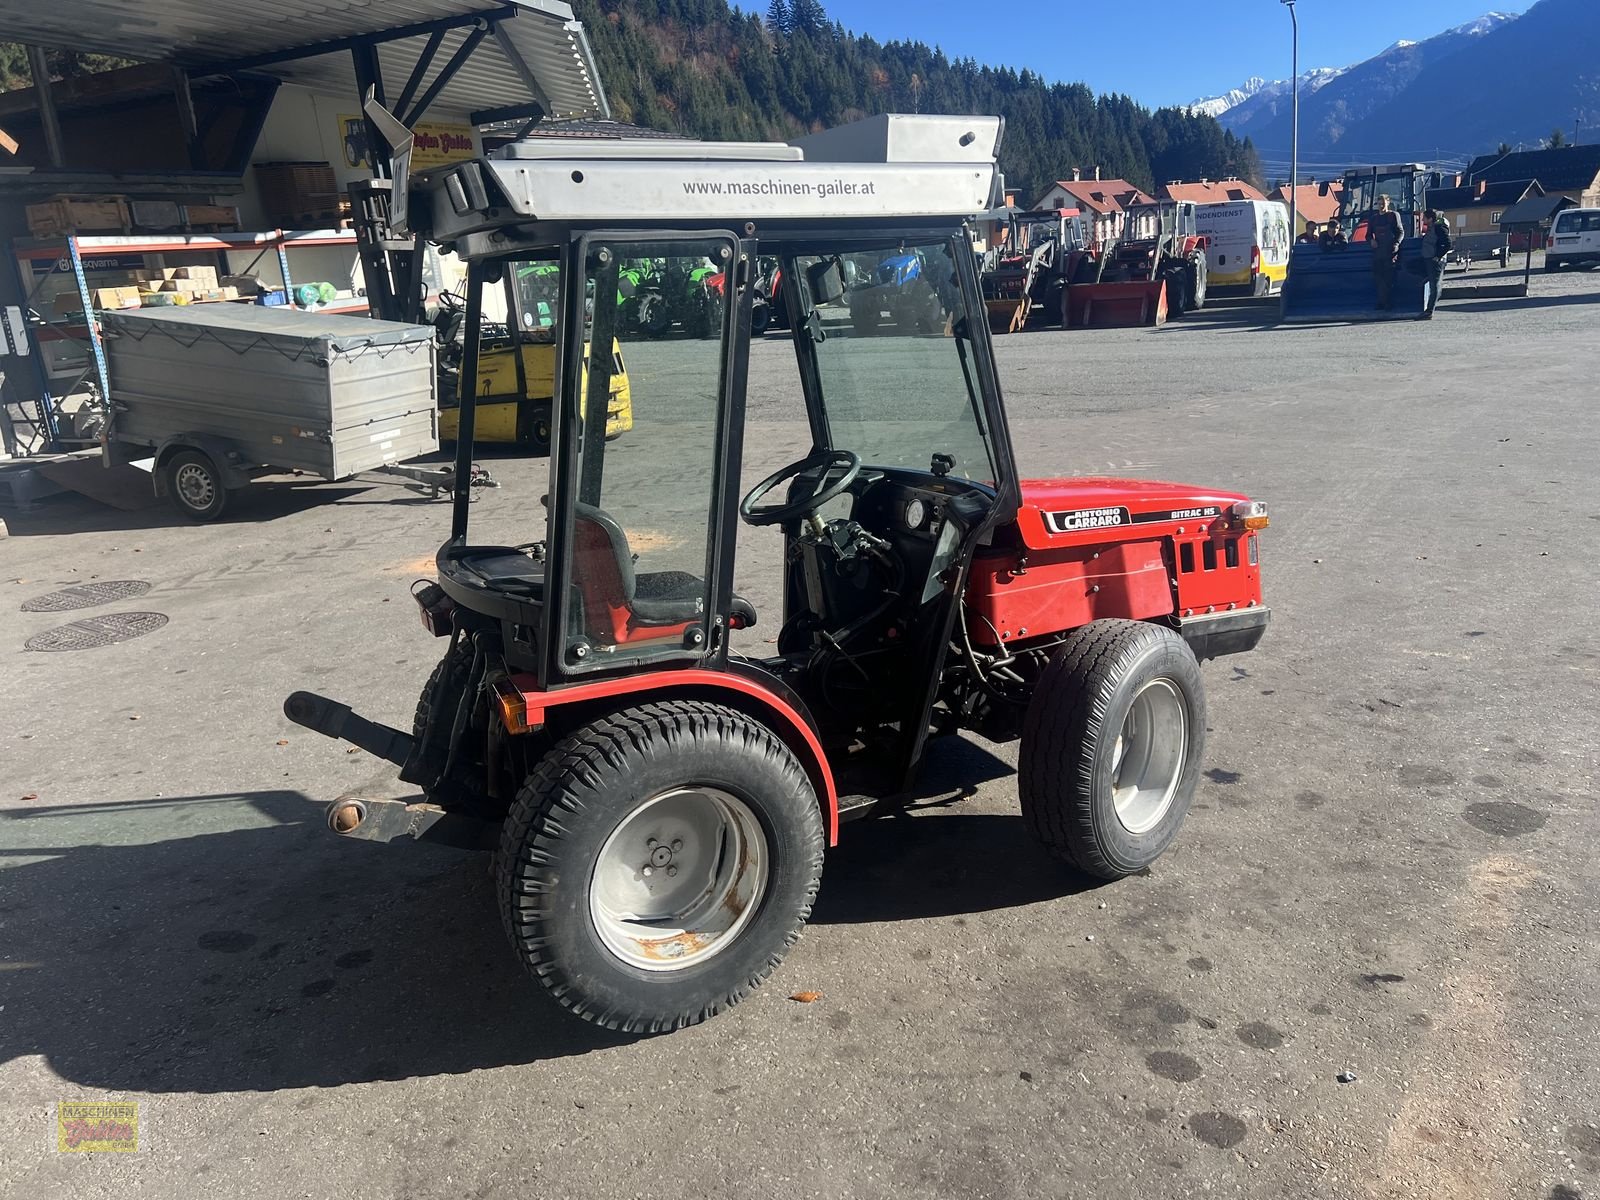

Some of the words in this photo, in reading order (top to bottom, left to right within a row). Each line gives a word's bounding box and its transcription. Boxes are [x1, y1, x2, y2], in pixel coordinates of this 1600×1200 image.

[683, 180, 875, 199] www.maschinen-gailer.at
[1074, 508, 1120, 519] ANTONIO
[1171, 509, 1202, 519] BITRAC
[1203, 508, 1215, 516] HS
[1064, 515, 1121, 530] CARRARO
